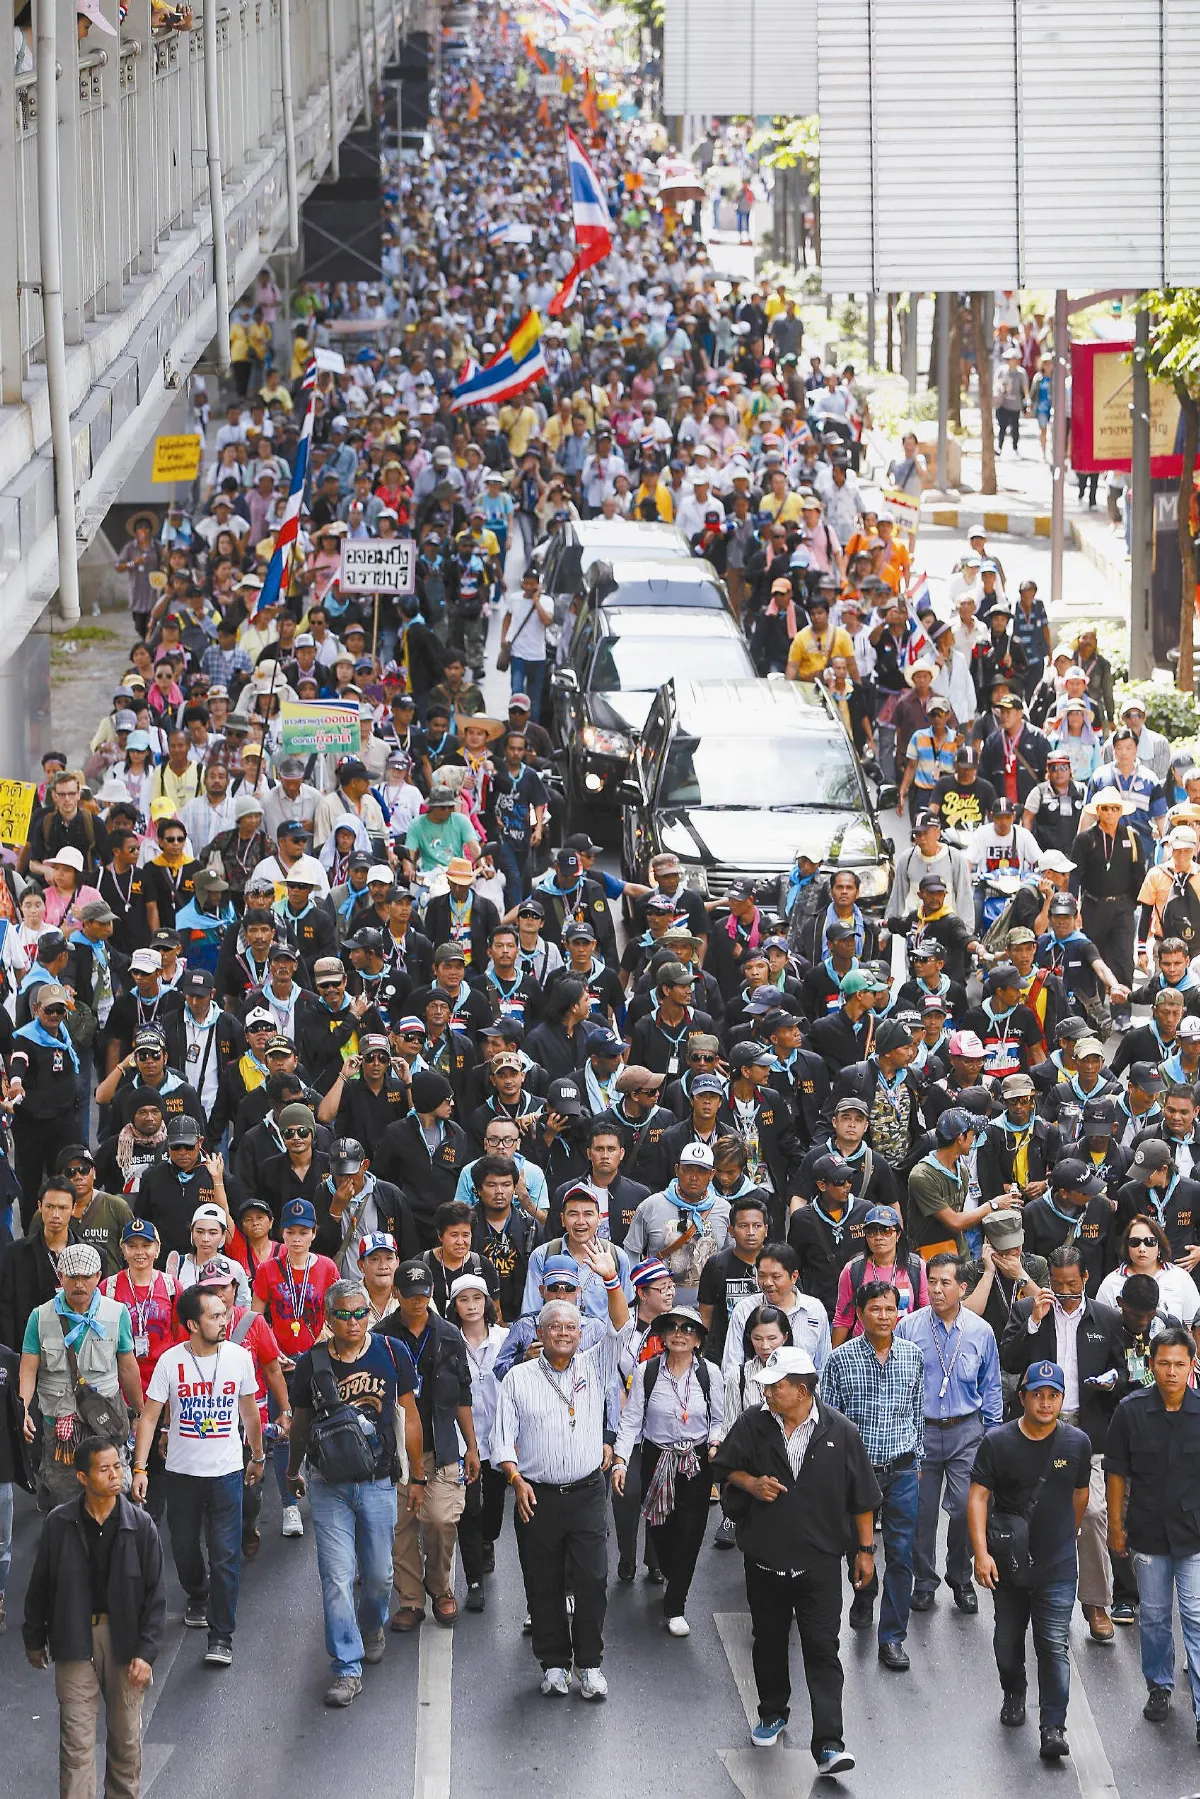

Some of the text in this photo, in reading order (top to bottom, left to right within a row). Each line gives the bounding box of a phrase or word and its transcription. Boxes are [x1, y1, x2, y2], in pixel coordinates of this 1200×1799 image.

[942, 791, 980, 814] Body
[178, 1364, 185, 1383] I
[178, 1381, 236, 1397] am a
